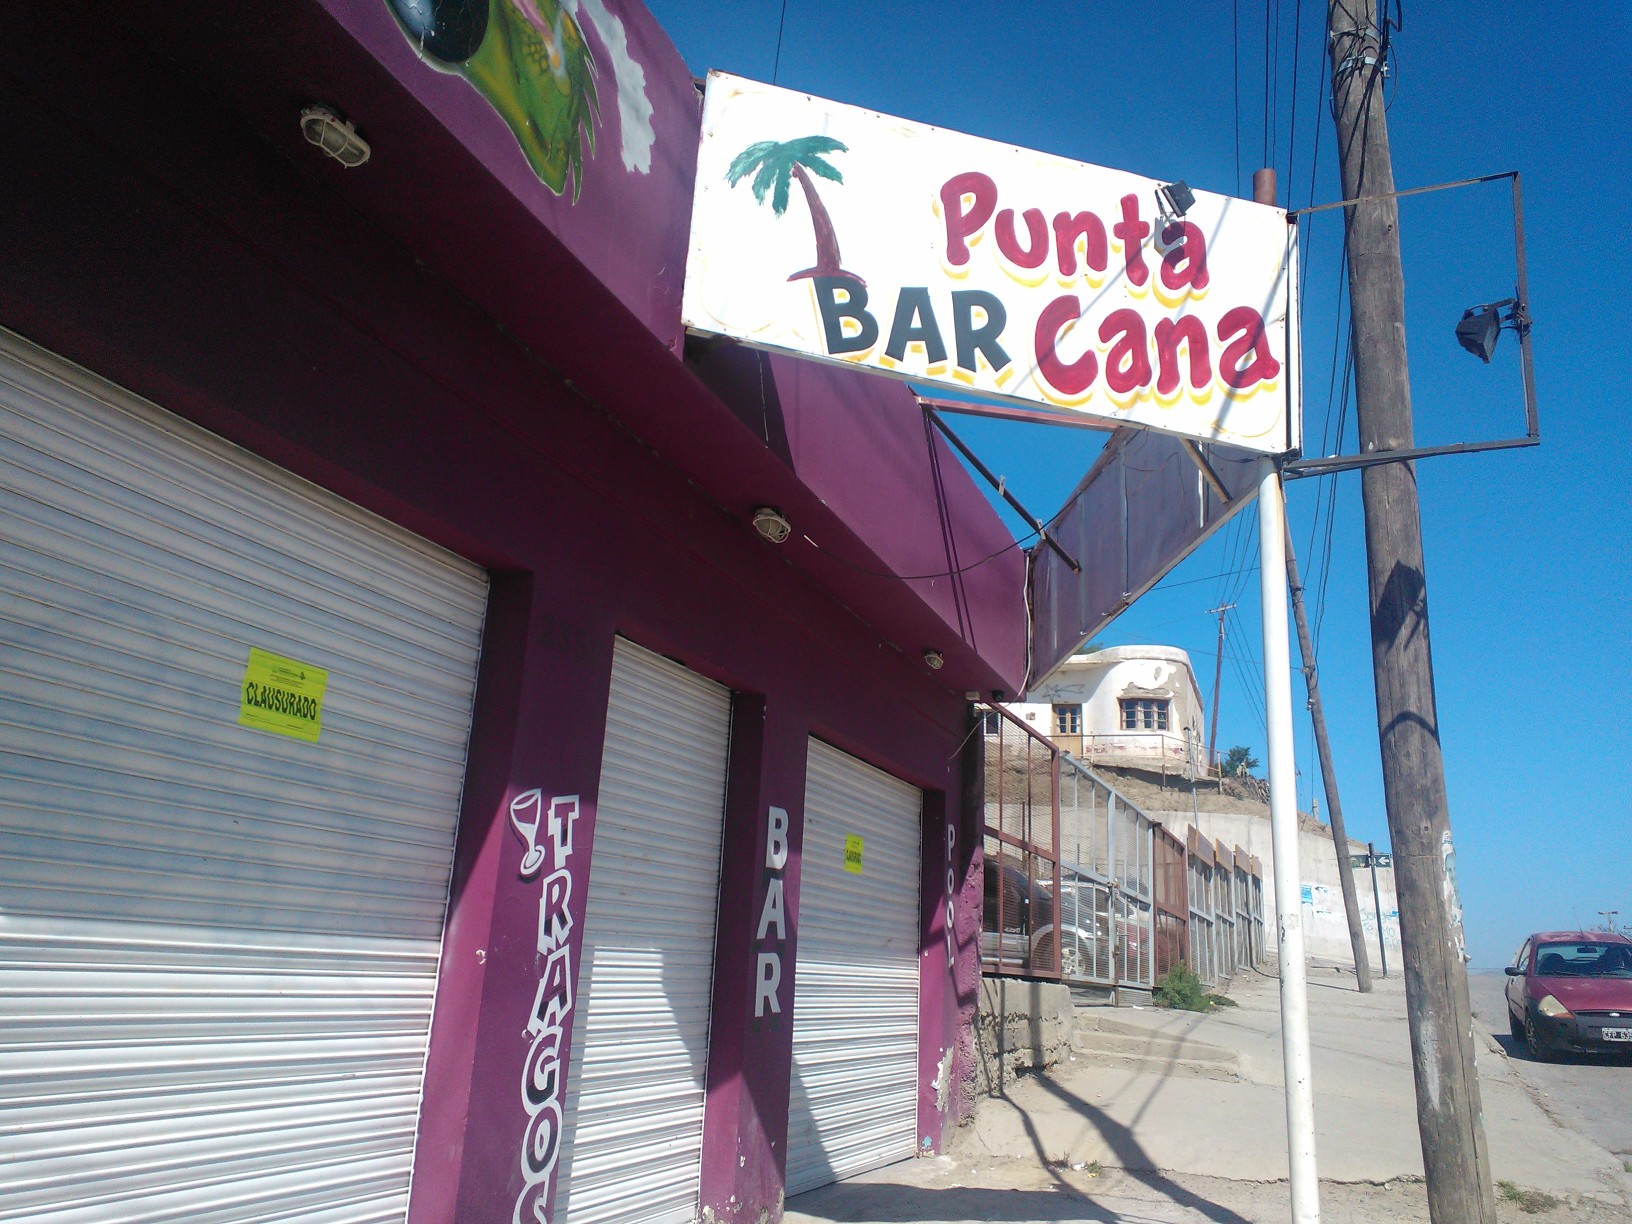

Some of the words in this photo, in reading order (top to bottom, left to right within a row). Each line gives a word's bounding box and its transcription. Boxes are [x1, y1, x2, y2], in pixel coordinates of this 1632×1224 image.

[940, 171, 1210, 292] Punta
[812, 275, 1012, 373] BAR
[1033, 294, 1281, 396] Cana
[246, 682, 317, 721] CLAUSURADO
[755, 805, 789, 1018] BAR
[946, 823, 956, 969] POOL
